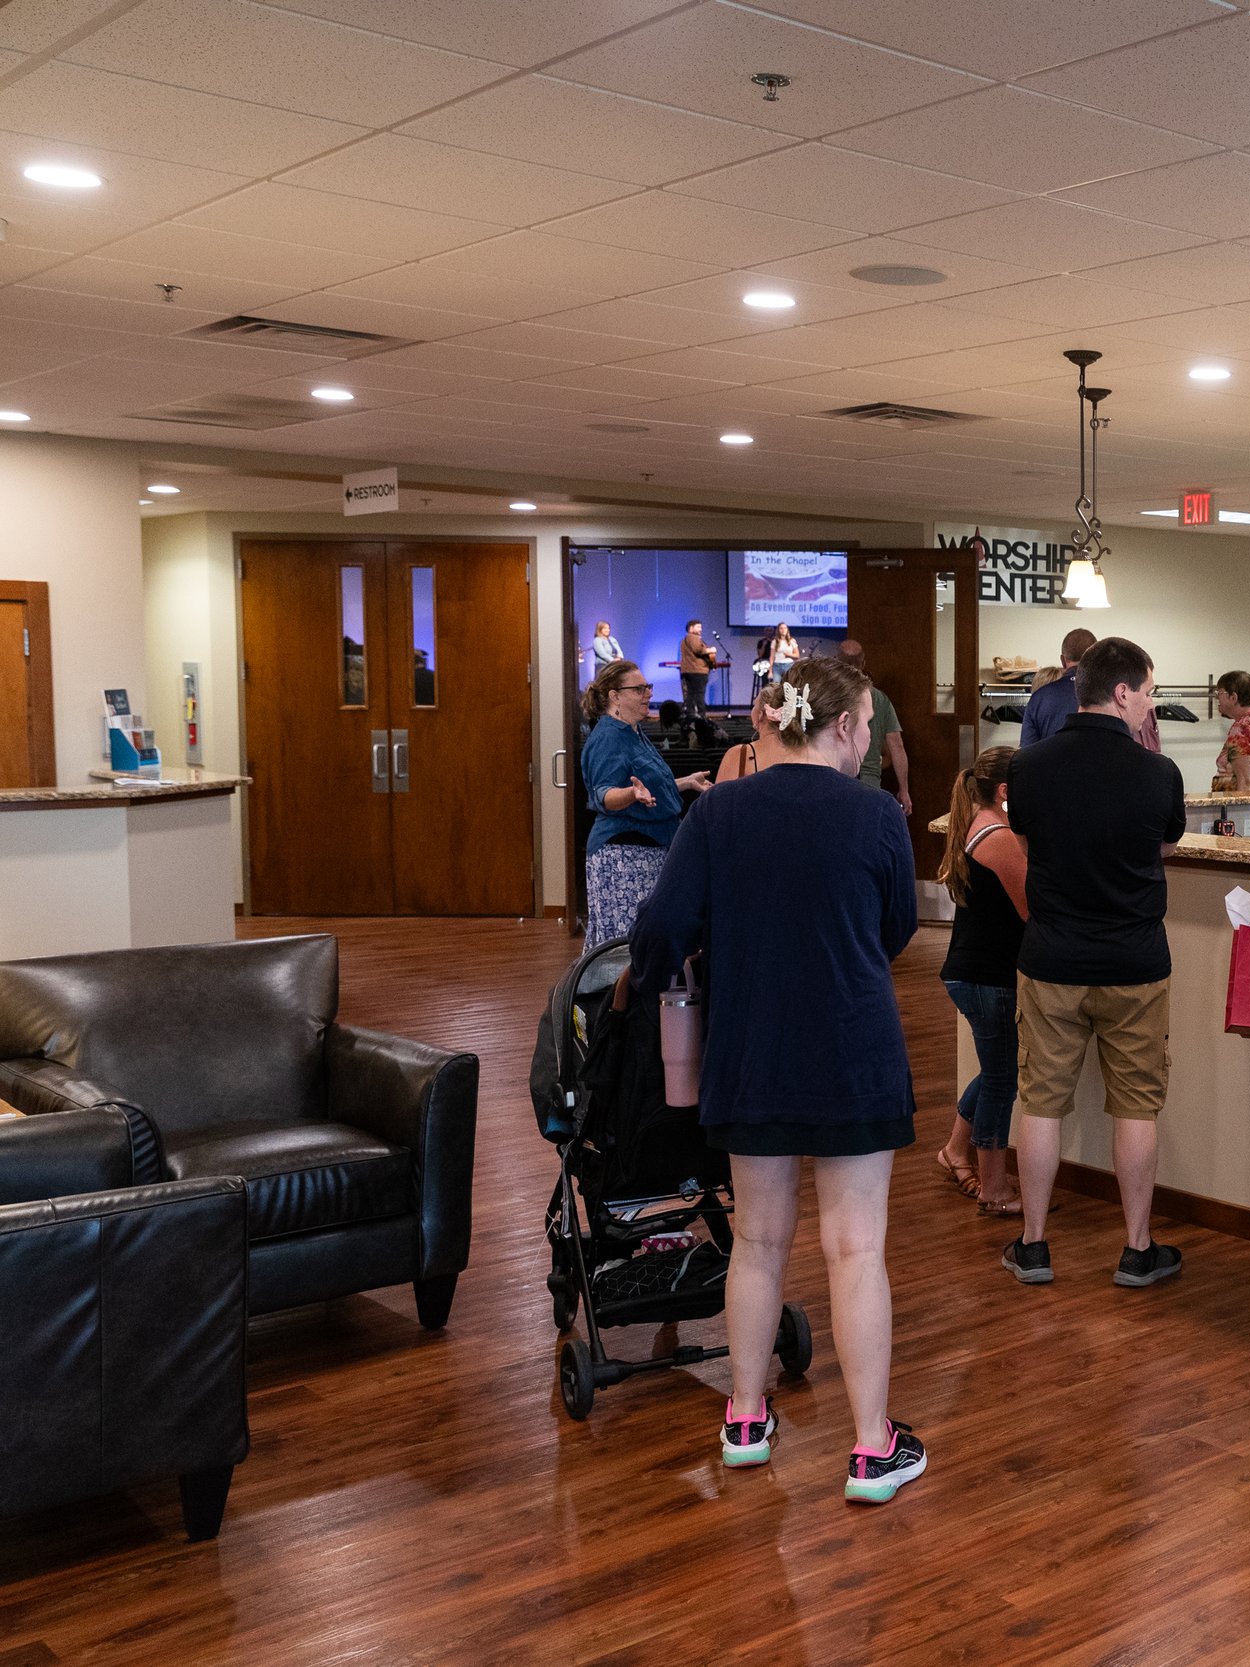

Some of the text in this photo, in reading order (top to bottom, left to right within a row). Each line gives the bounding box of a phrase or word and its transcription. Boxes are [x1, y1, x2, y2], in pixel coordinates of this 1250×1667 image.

[354, 483, 396, 500] RESTROOM
[1183, 493, 1212, 525] EXIT
[751, 556, 817, 566] In the Chapel
[938, 571, 1068, 604] ENTER
[751, 603, 760, 611] An
[763, 603, 796, 613] Evening
[801, 615, 819, 624] Sign
[822, 616, 832, 625] up
